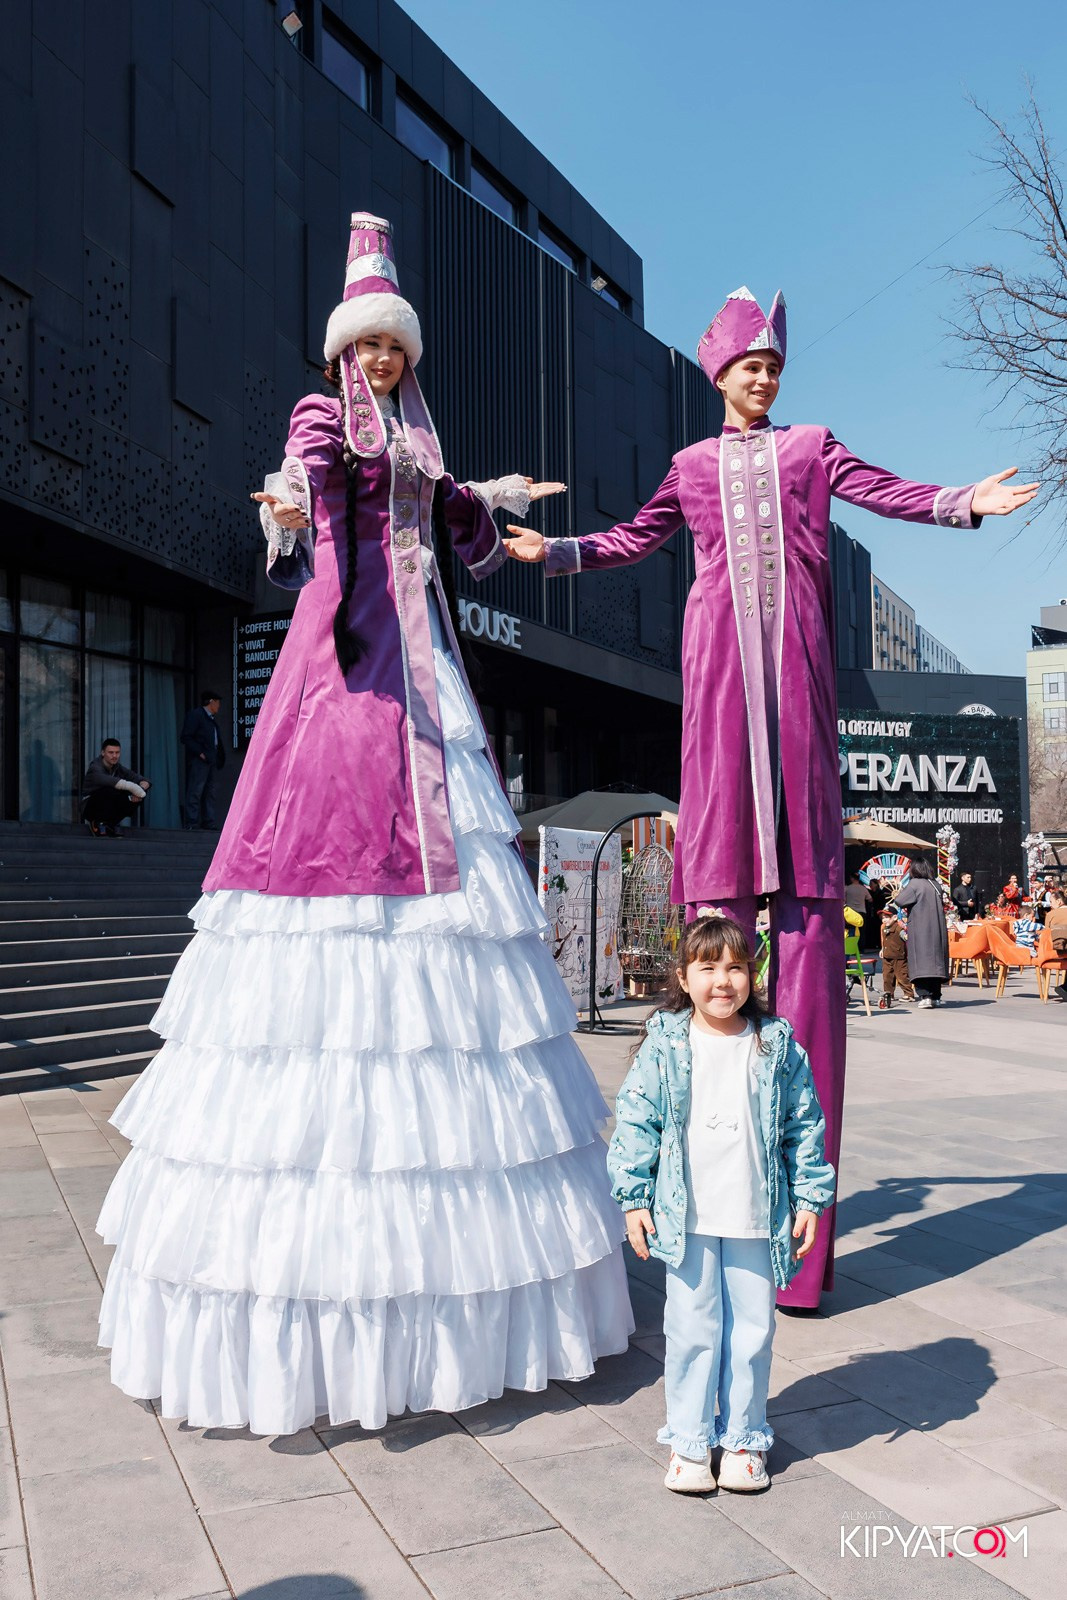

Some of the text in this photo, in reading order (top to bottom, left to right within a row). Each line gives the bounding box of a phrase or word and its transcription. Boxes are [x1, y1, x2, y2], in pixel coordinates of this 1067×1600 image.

[245, 621, 272, 634] COFFEE
[245, 639, 266, 650] VIVAT
[245, 651, 278, 662] BANQUET
[245, 668, 271, 679] KINDER
[245, 684, 269, 697] GRAM
[847, 719, 913, 738] ORTALYGY
[938, 807, 1004, 824] КОМПЛЕКС
